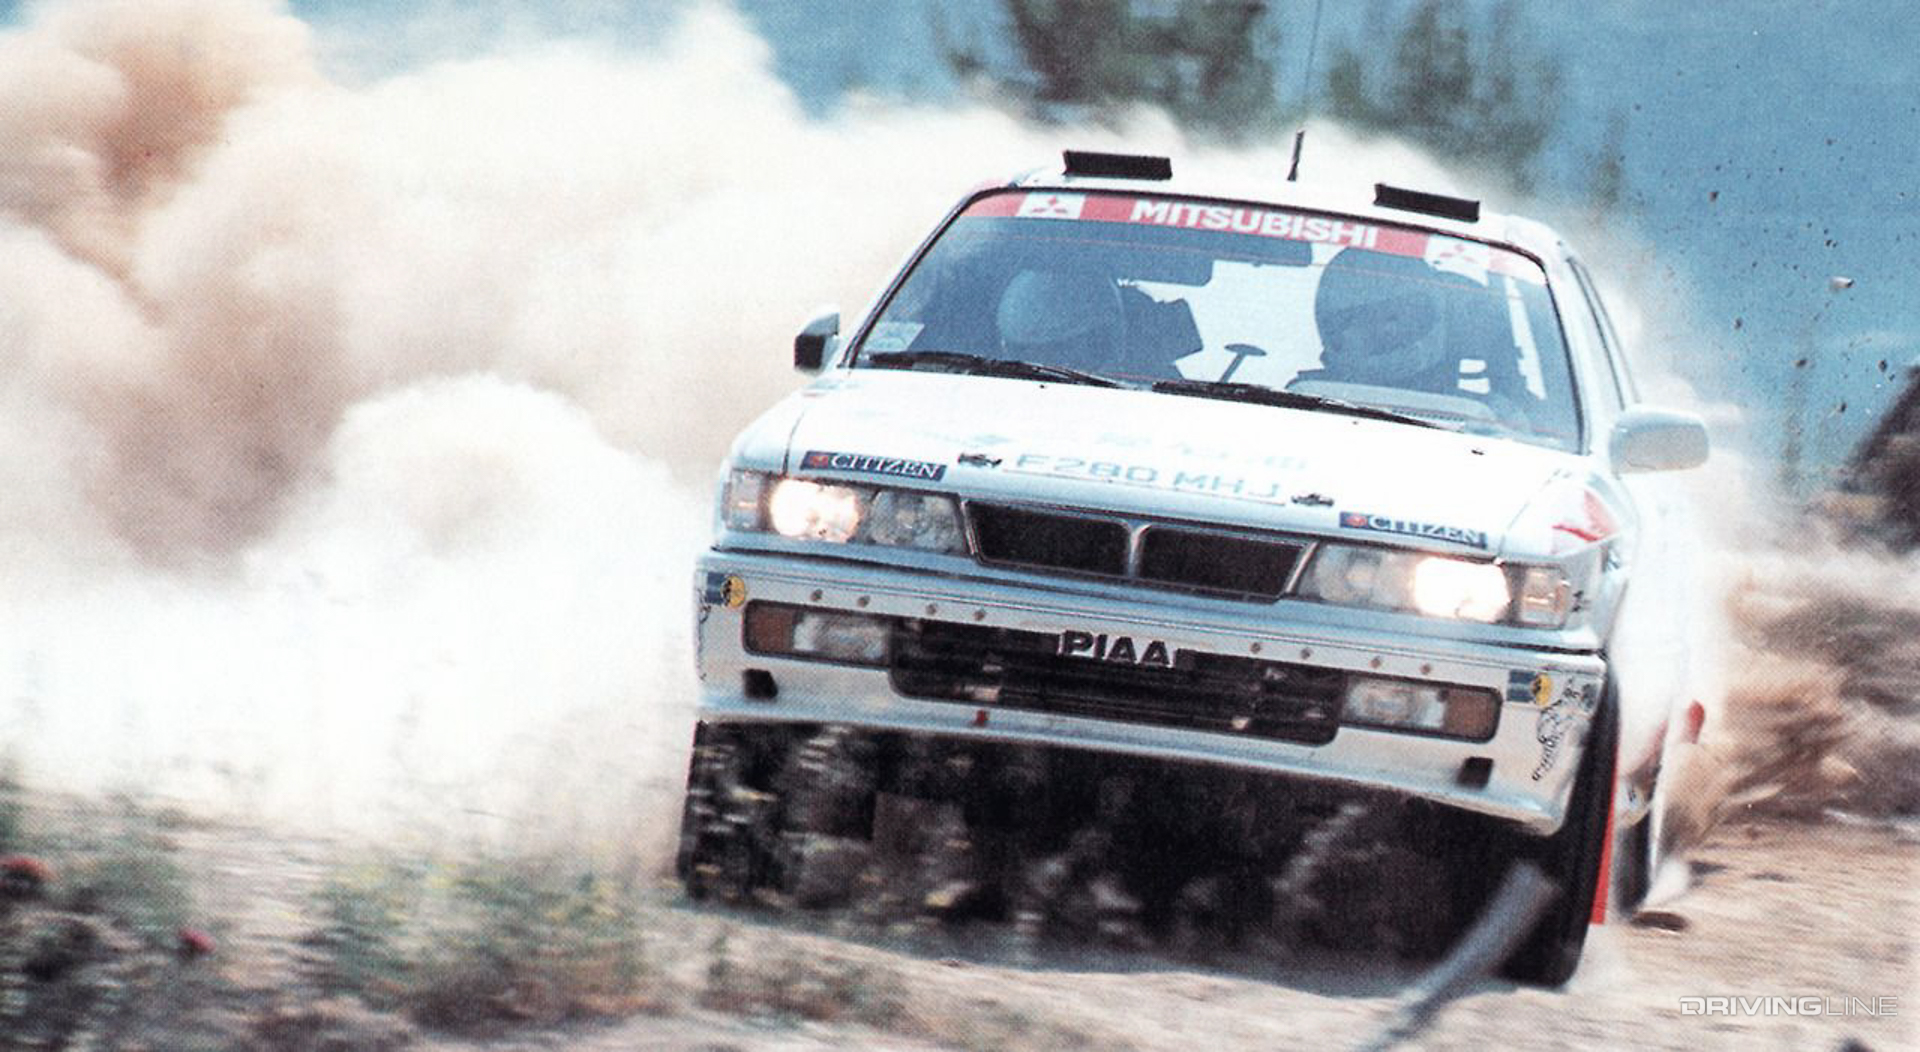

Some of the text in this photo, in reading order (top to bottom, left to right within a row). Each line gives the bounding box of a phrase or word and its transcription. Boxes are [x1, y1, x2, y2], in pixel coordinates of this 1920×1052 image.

[1130, 200, 1377, 247] MITSUBISHI
[831, 455, 939, 478] CITIZEN
[1017, 453, 1158, 482] F280
[1368, 514, 1479, 544] CITIZEN
[1061, 629, 1173, 668] PIAA
